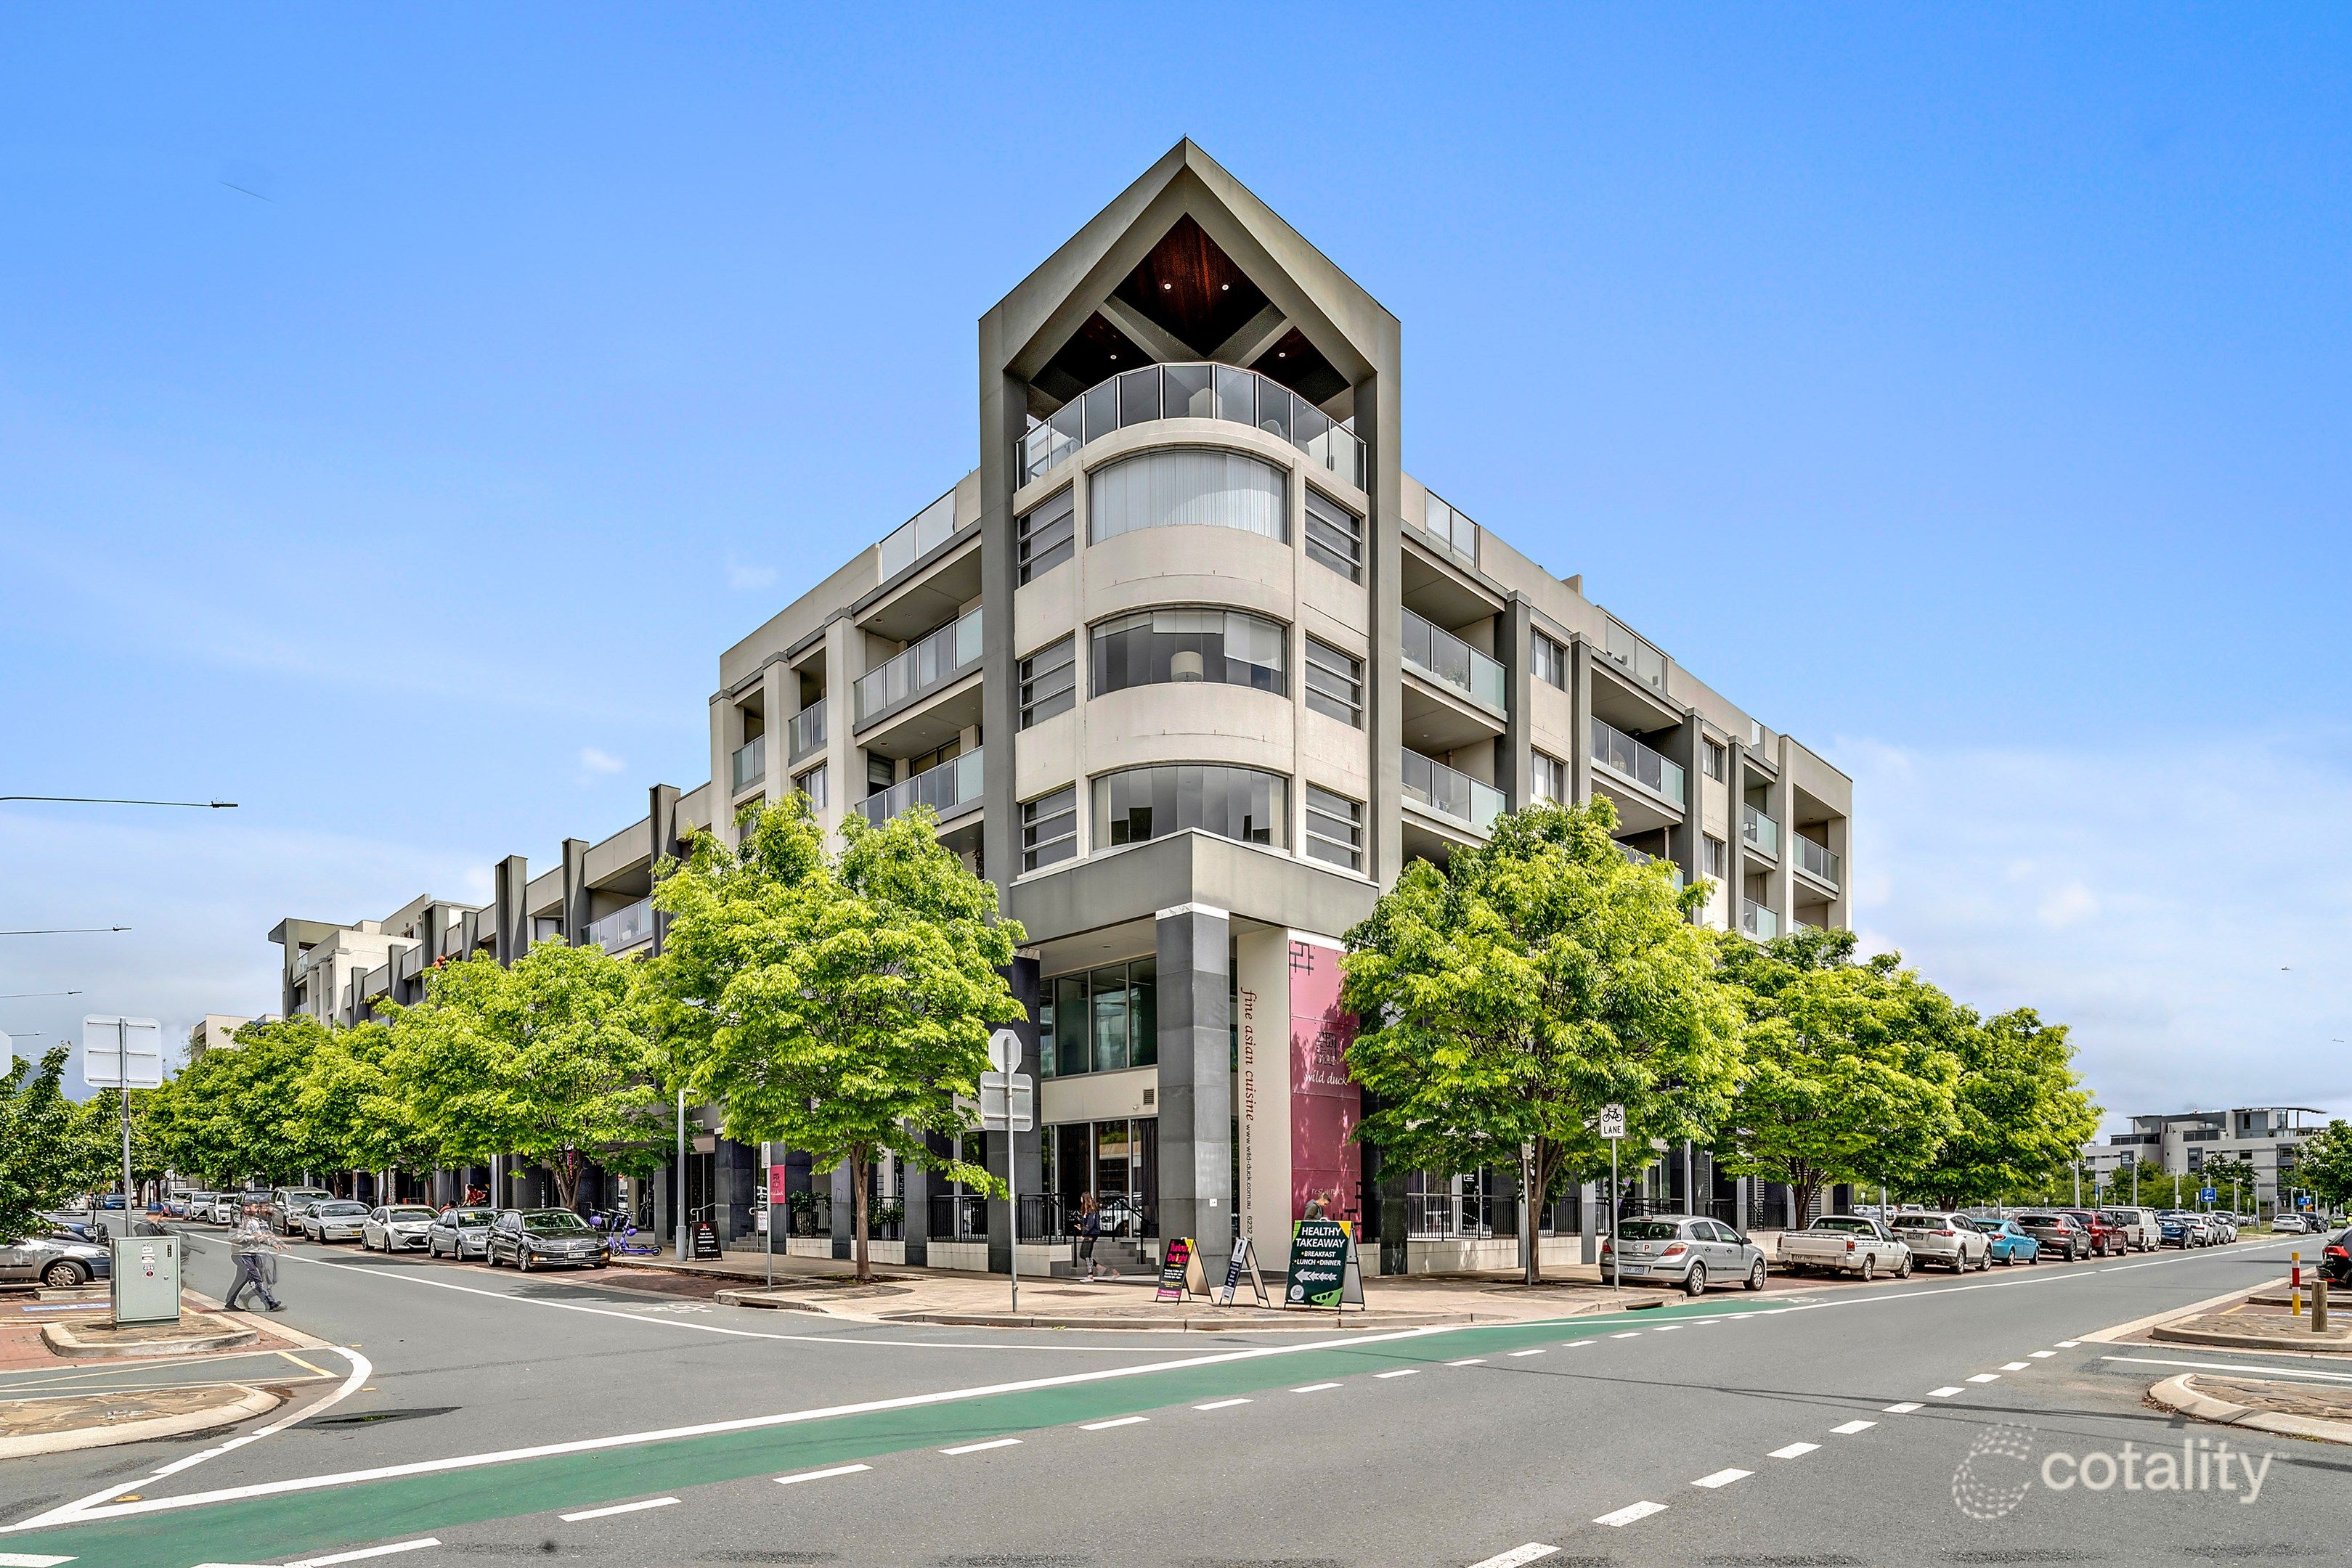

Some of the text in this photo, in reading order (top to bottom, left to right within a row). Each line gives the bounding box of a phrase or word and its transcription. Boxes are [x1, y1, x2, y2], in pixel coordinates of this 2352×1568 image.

[1240, 987, 1257, 1121] fine asian cuisine
[1304, 1070, 1348, 1086] wild duck
[1301, 1227, 1342, 1236] HEALTHY
[1295, 1238, 1346, 1248] TAKEAWAY
